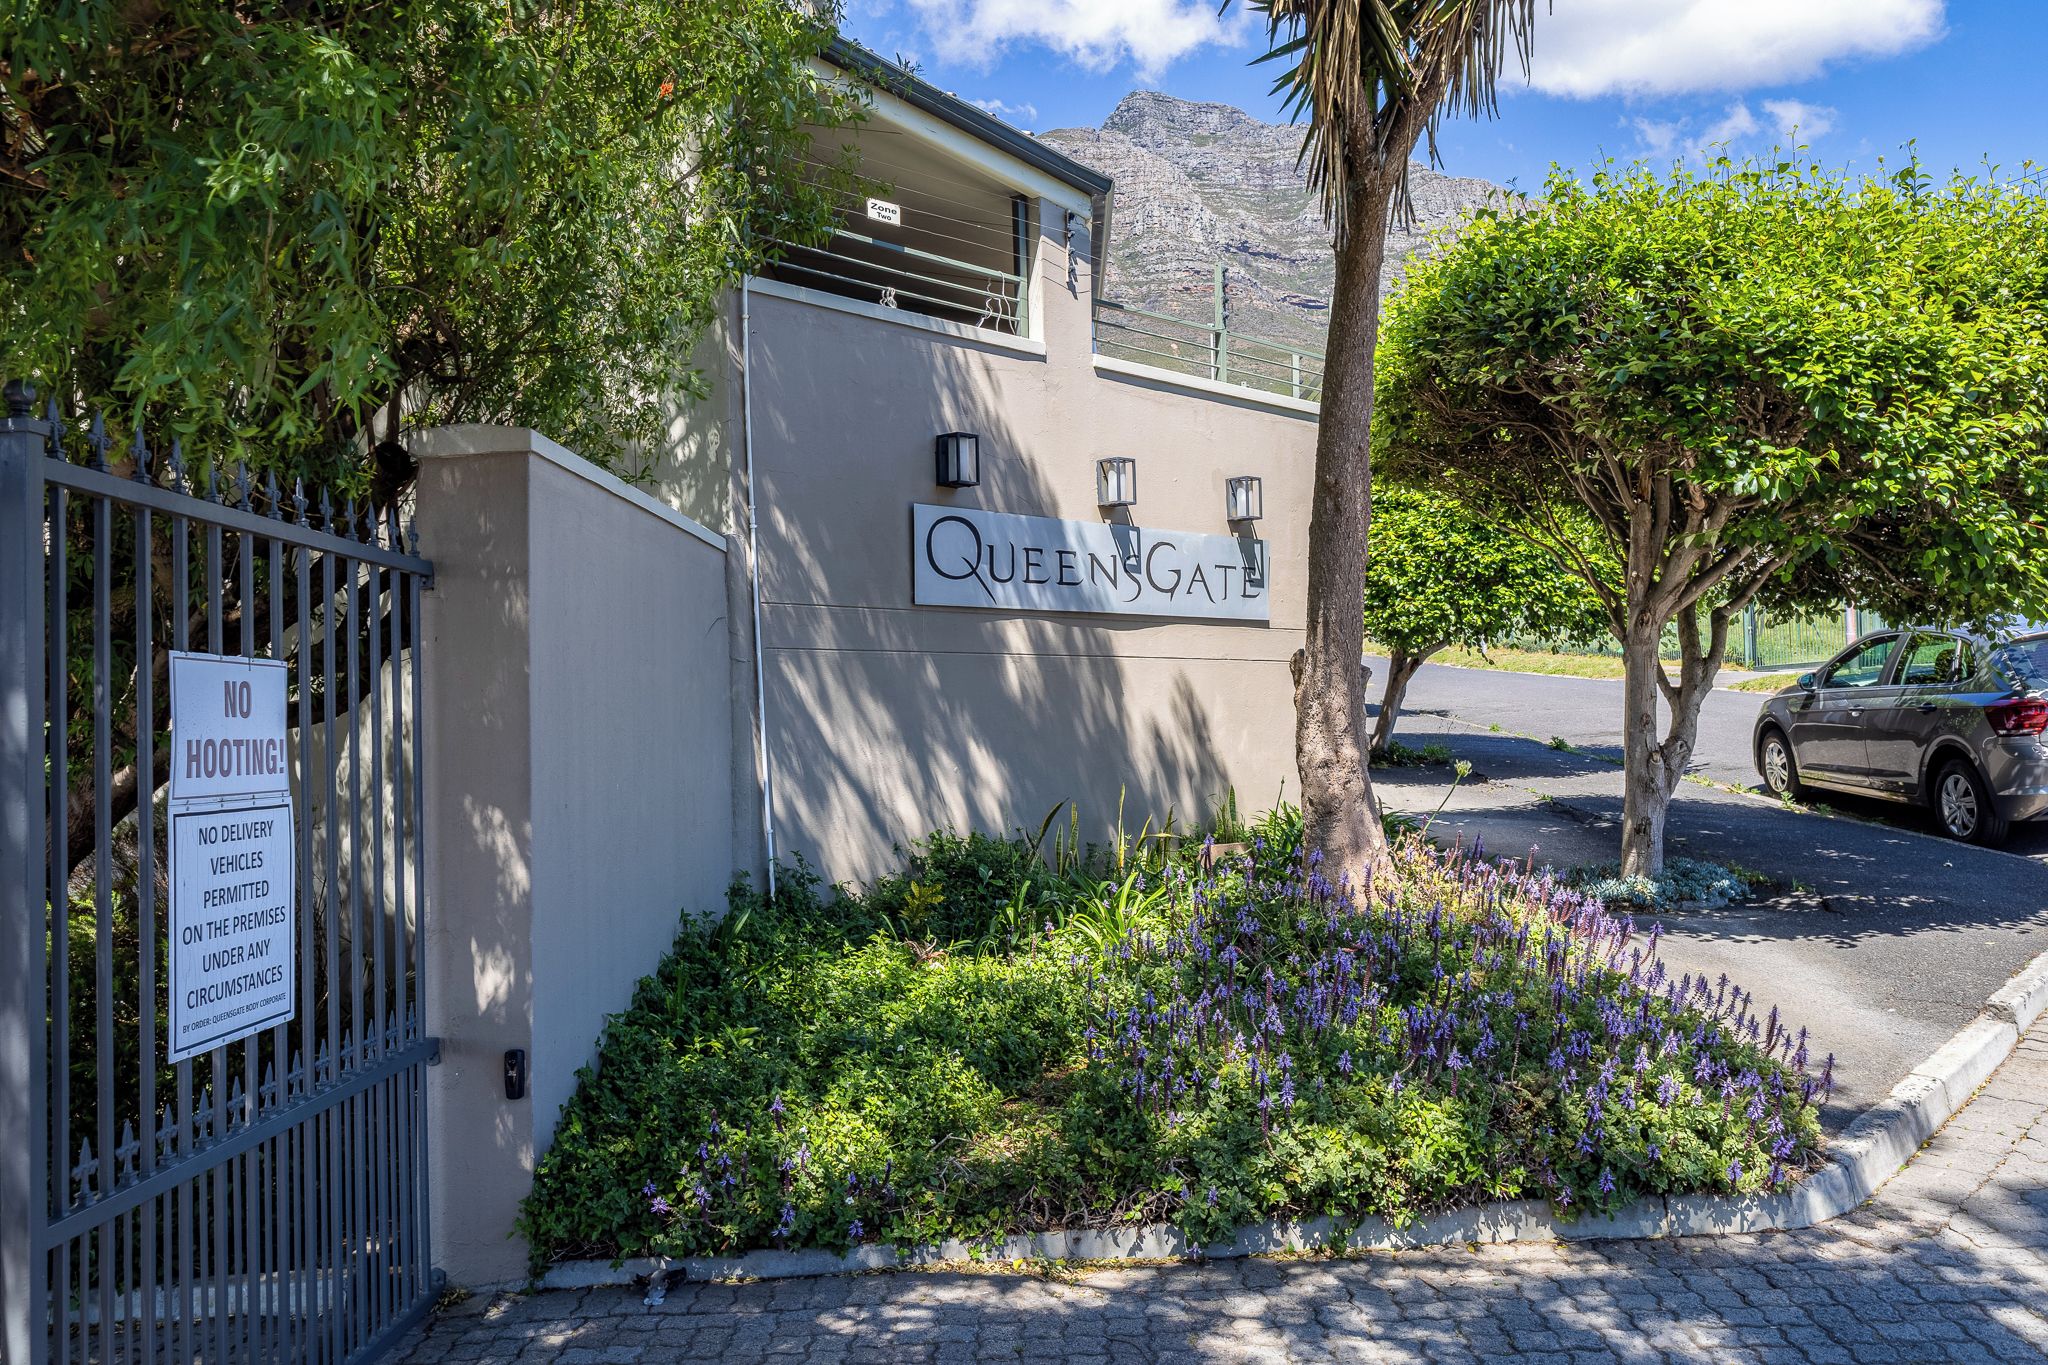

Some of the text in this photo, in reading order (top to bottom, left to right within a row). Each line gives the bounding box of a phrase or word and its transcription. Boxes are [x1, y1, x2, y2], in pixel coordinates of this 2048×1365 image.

[870, 202, 897, 215] Zone
[876, 211, 892, 221] Two
[224, 681, 251, 718] NO
[186, 738, 284, 778] HOOTING!
[199, 820, 274, 846] NO DELIVERY
[210, 851, 263, 876] VEHICLES
[203, 880, 269, 909] PERMITTED
[182, 905, 286, 946] ON THE PREMISES
[202, 938, 271, 973] UNDER ANY
[187, 964, 283, 1010] CIRCUMSTANCES
[182, 992, 287, 1034] BY ORDER: QUEENSGATE BODY CORPORATE
